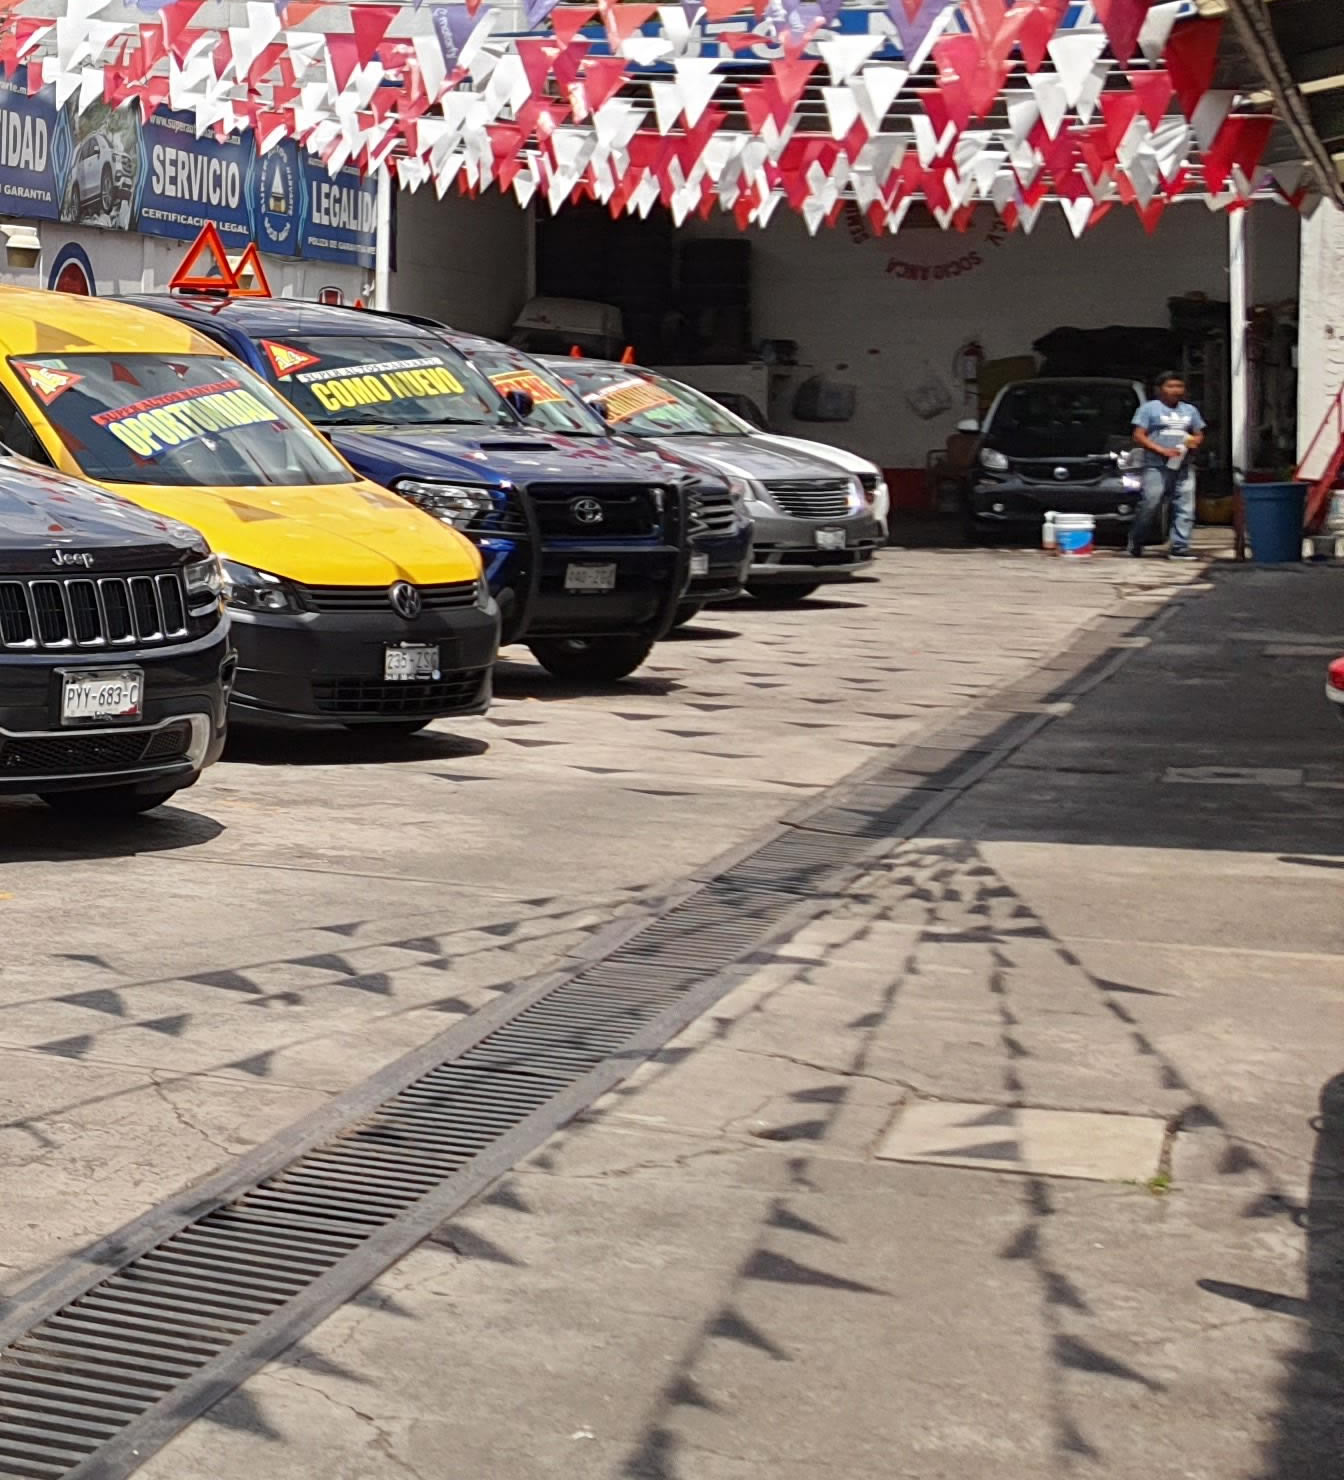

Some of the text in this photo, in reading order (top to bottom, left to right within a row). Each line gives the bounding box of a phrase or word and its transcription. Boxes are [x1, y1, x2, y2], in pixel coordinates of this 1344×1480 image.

[4, 184, 52, 202] GARANTIA
[152, 144, 240, 209] SERVICIO
[312, 180, 378, 233] LEGALIDA
[219, 221, 249, 235] LEGAL
[310, 375, 393, 412] COMO
[380, 366, 465, 399] NUEVO
[108, 389, 279, 456] OPORTUNIDAD
[52, 549, 95, 568] Jeep
[66, 684, 139, 710] PYY-683-C
